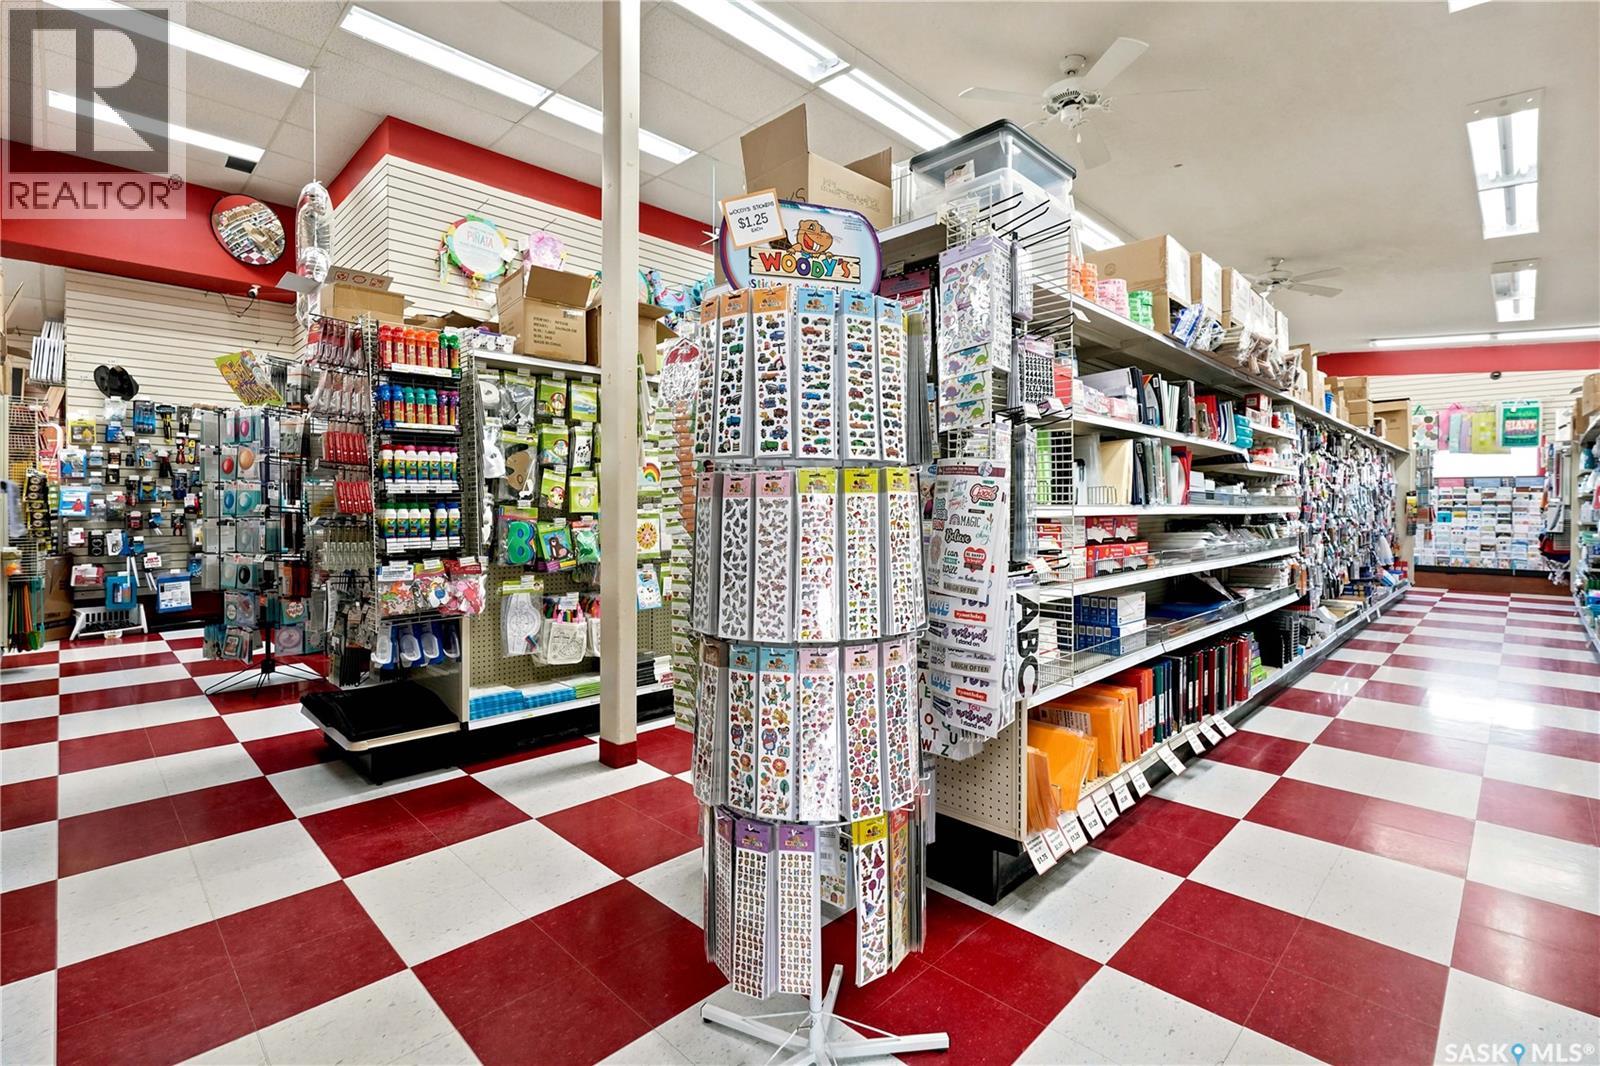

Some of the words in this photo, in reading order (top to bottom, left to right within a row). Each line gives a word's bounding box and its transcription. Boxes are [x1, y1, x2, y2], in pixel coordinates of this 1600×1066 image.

[738, 212, 769, 229] $1.25
[759, 251, 851, 279] WOODY'S
[960, 515, 982, 528] MAGIC
[945, 527, 972, 544] Believe
[947, 549, 959, 557] can
[1016, 593, 1039, 698] ABC
[968, 664, 990, 673] OFTEN
